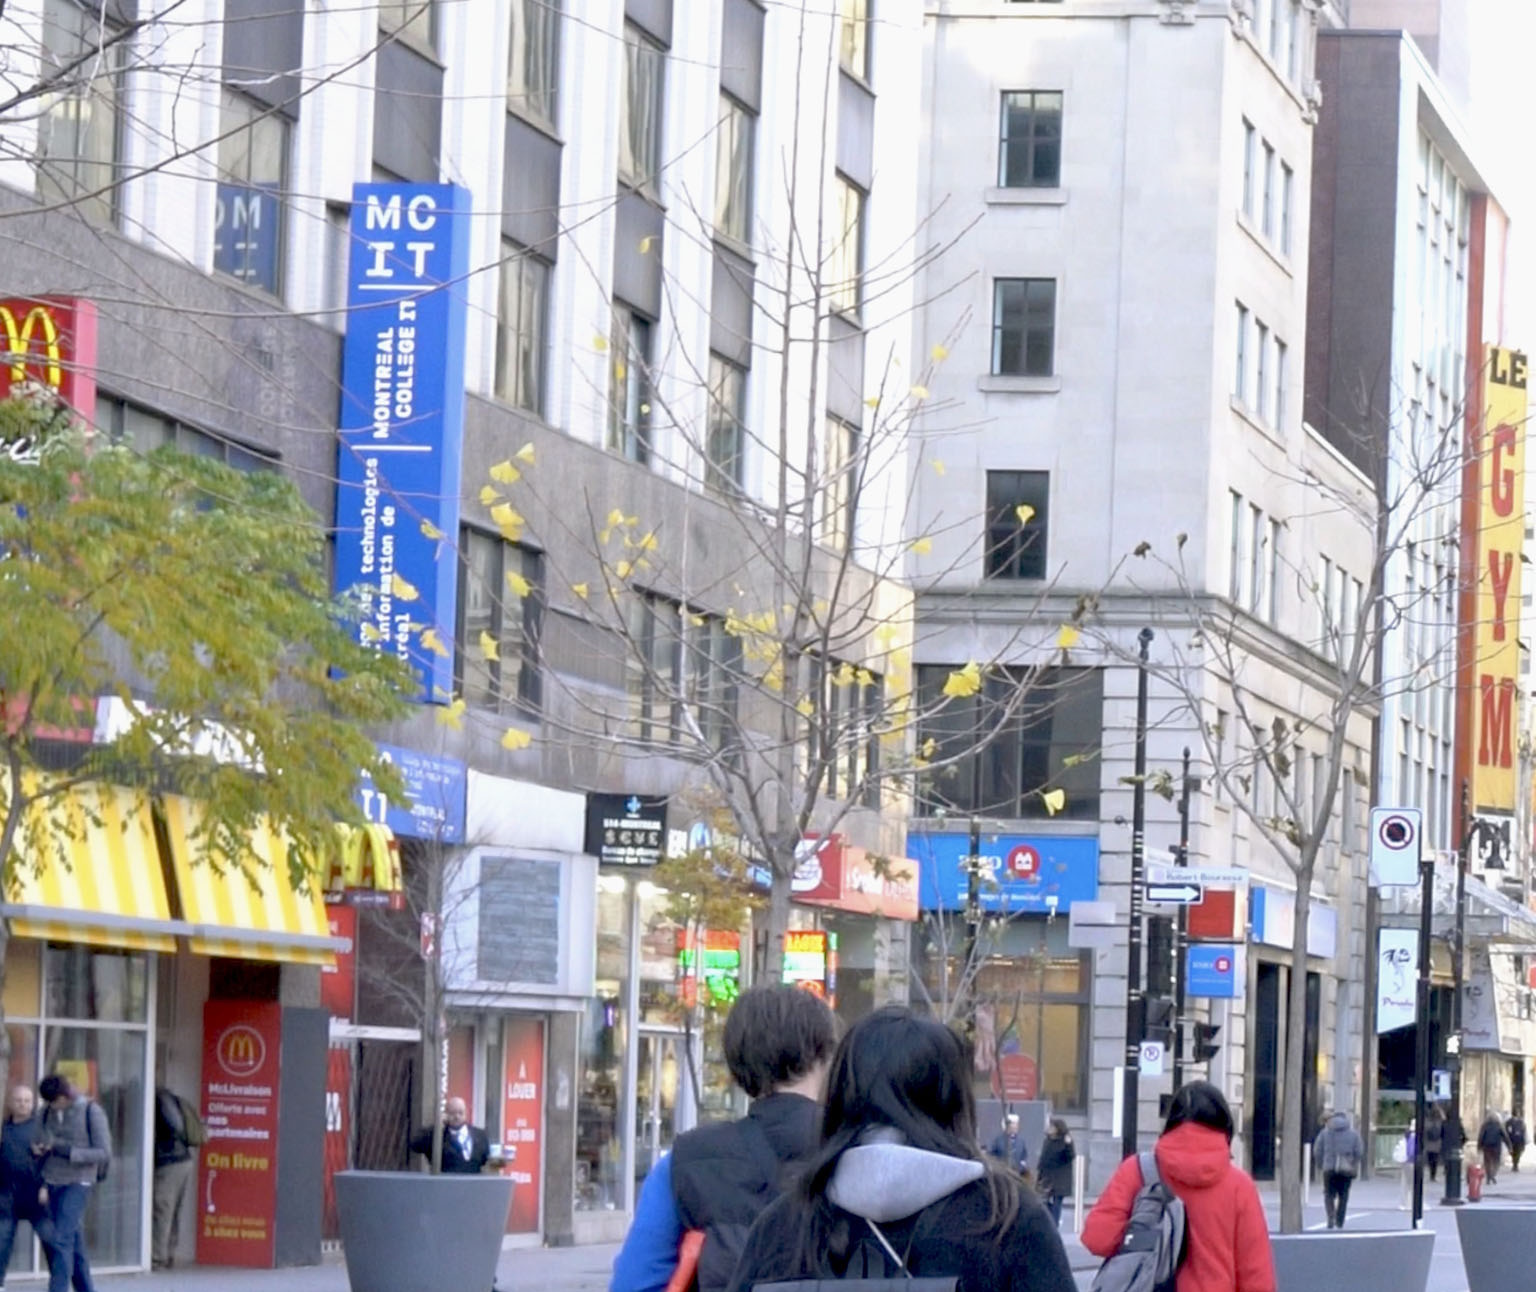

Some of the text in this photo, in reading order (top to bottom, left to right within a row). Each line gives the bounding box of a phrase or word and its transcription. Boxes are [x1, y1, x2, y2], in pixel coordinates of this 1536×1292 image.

[366, 194, 436, 231] MC
[366, 242, 435, 278] IT
[395, 326, 415, 418] COLLEGE
[1478, 423, 1518, 768] GYM
[207, 1152, 268, 1170] On livre
